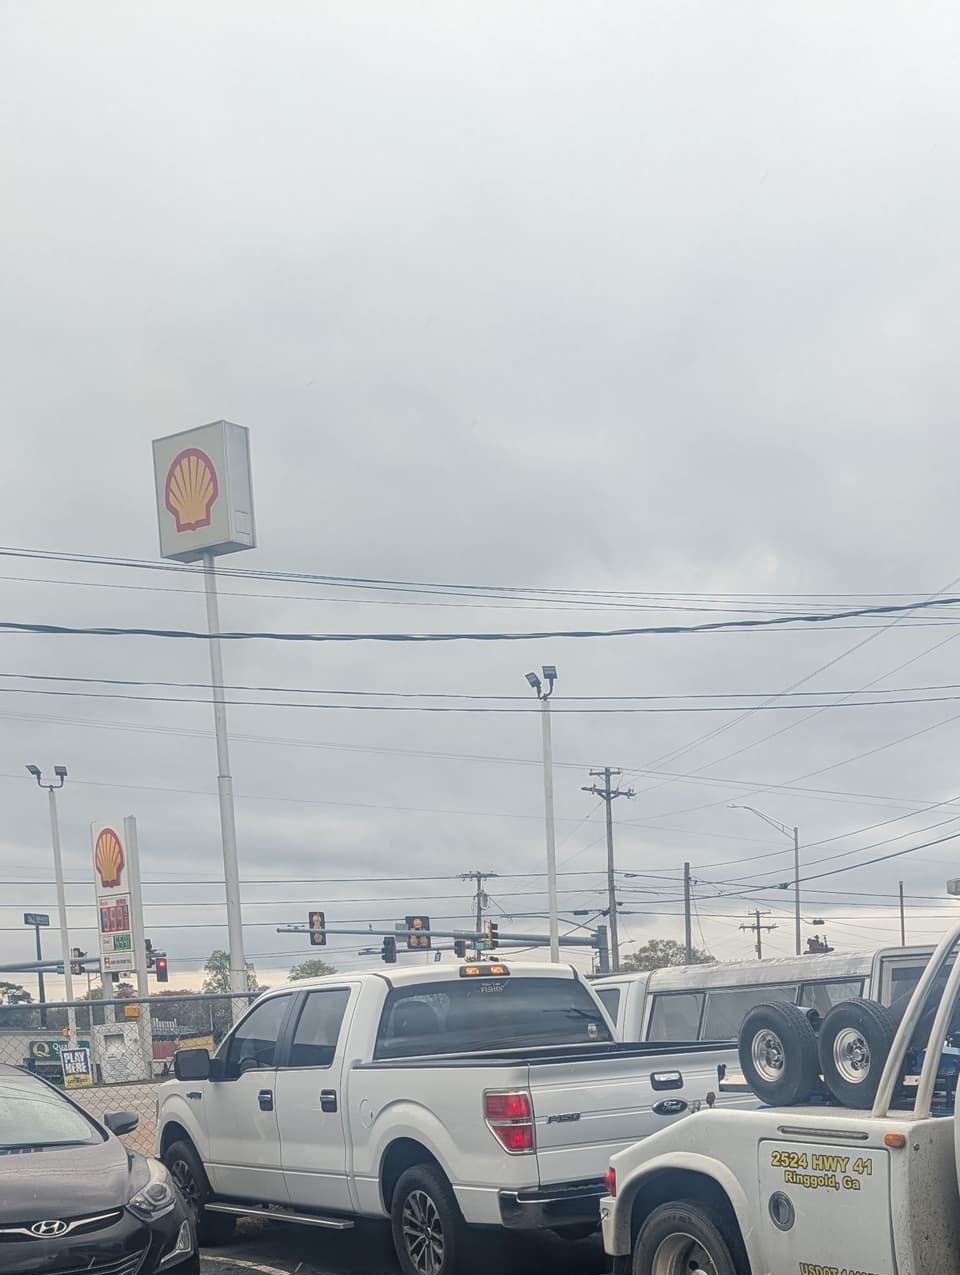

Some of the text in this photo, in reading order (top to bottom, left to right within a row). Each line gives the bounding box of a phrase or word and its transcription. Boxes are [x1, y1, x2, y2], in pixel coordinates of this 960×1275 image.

[63, 1051, 85, 1063] PLAY
[65, 1062, 87, 1074] HERE
[771, 1151, 873, 1175] 2524 HWY 41
[784, 1170, 861, 1190] Ringgold, Ga
